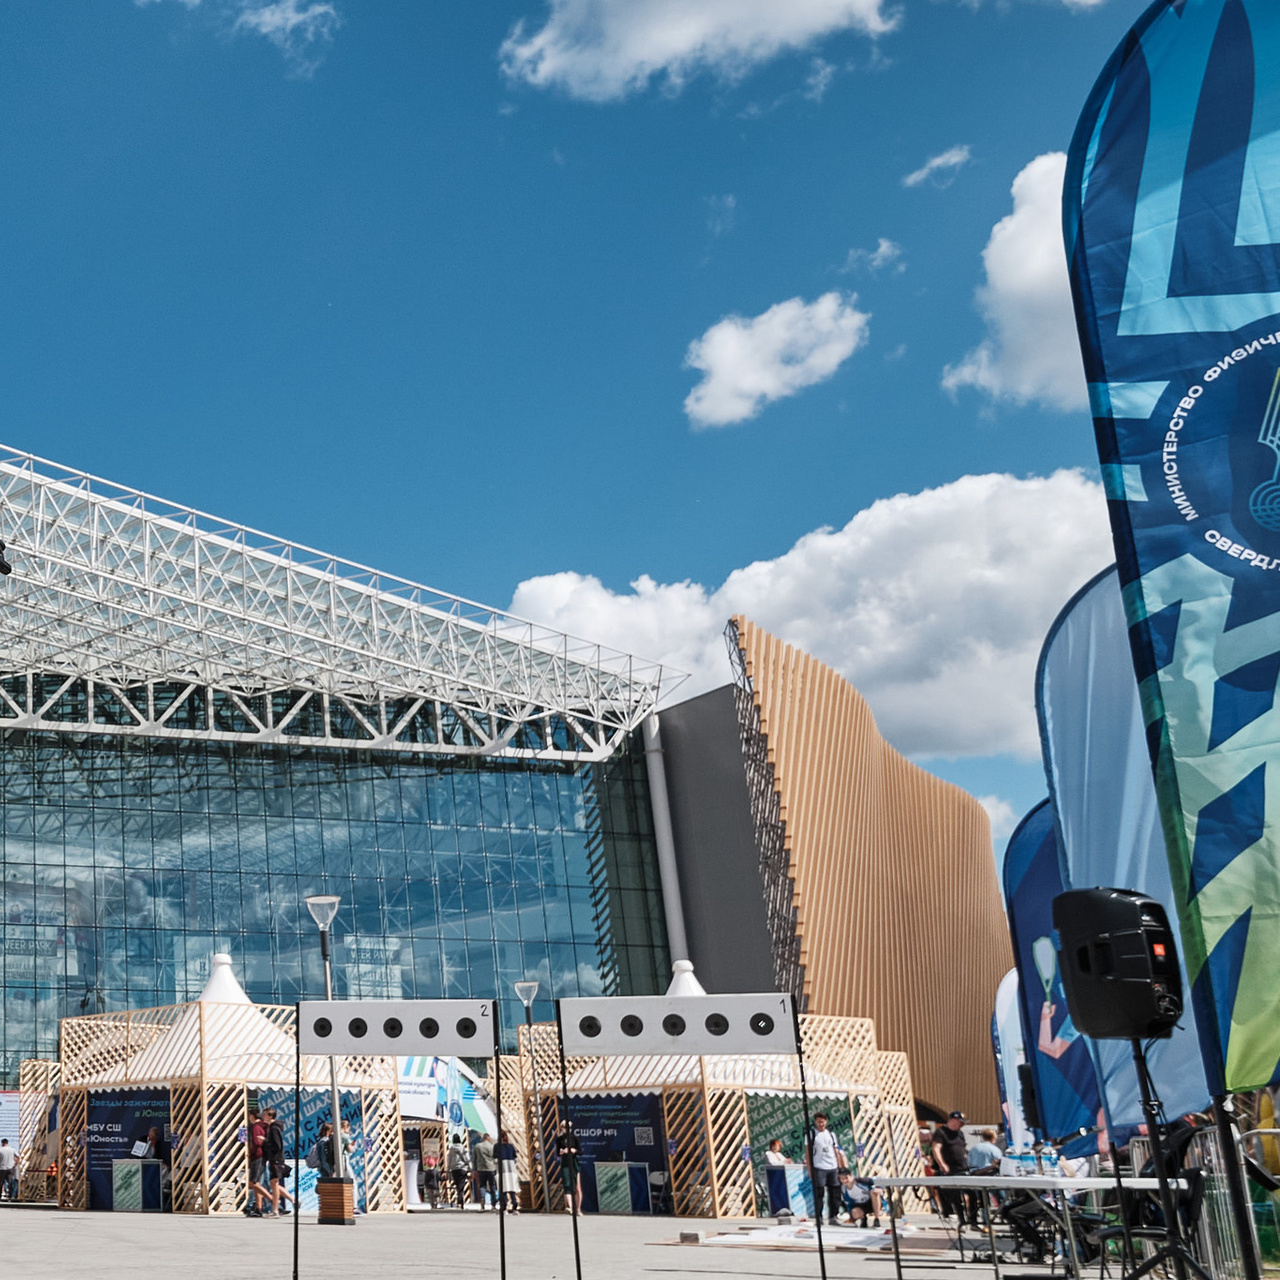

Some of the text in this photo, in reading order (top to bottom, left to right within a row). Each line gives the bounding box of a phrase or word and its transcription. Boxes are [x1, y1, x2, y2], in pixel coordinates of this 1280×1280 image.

[1162, 384, 1204, 522] МИНИСТЕРСТВО
[480, 1004, 490, 1017] 2
[779, 998, 787, 1014] 1
[124, 1099, 170, 1107] зажигают
[106, 1123, 122, 1132] СШ
[573, 1128, 603, 1137] СШОР
